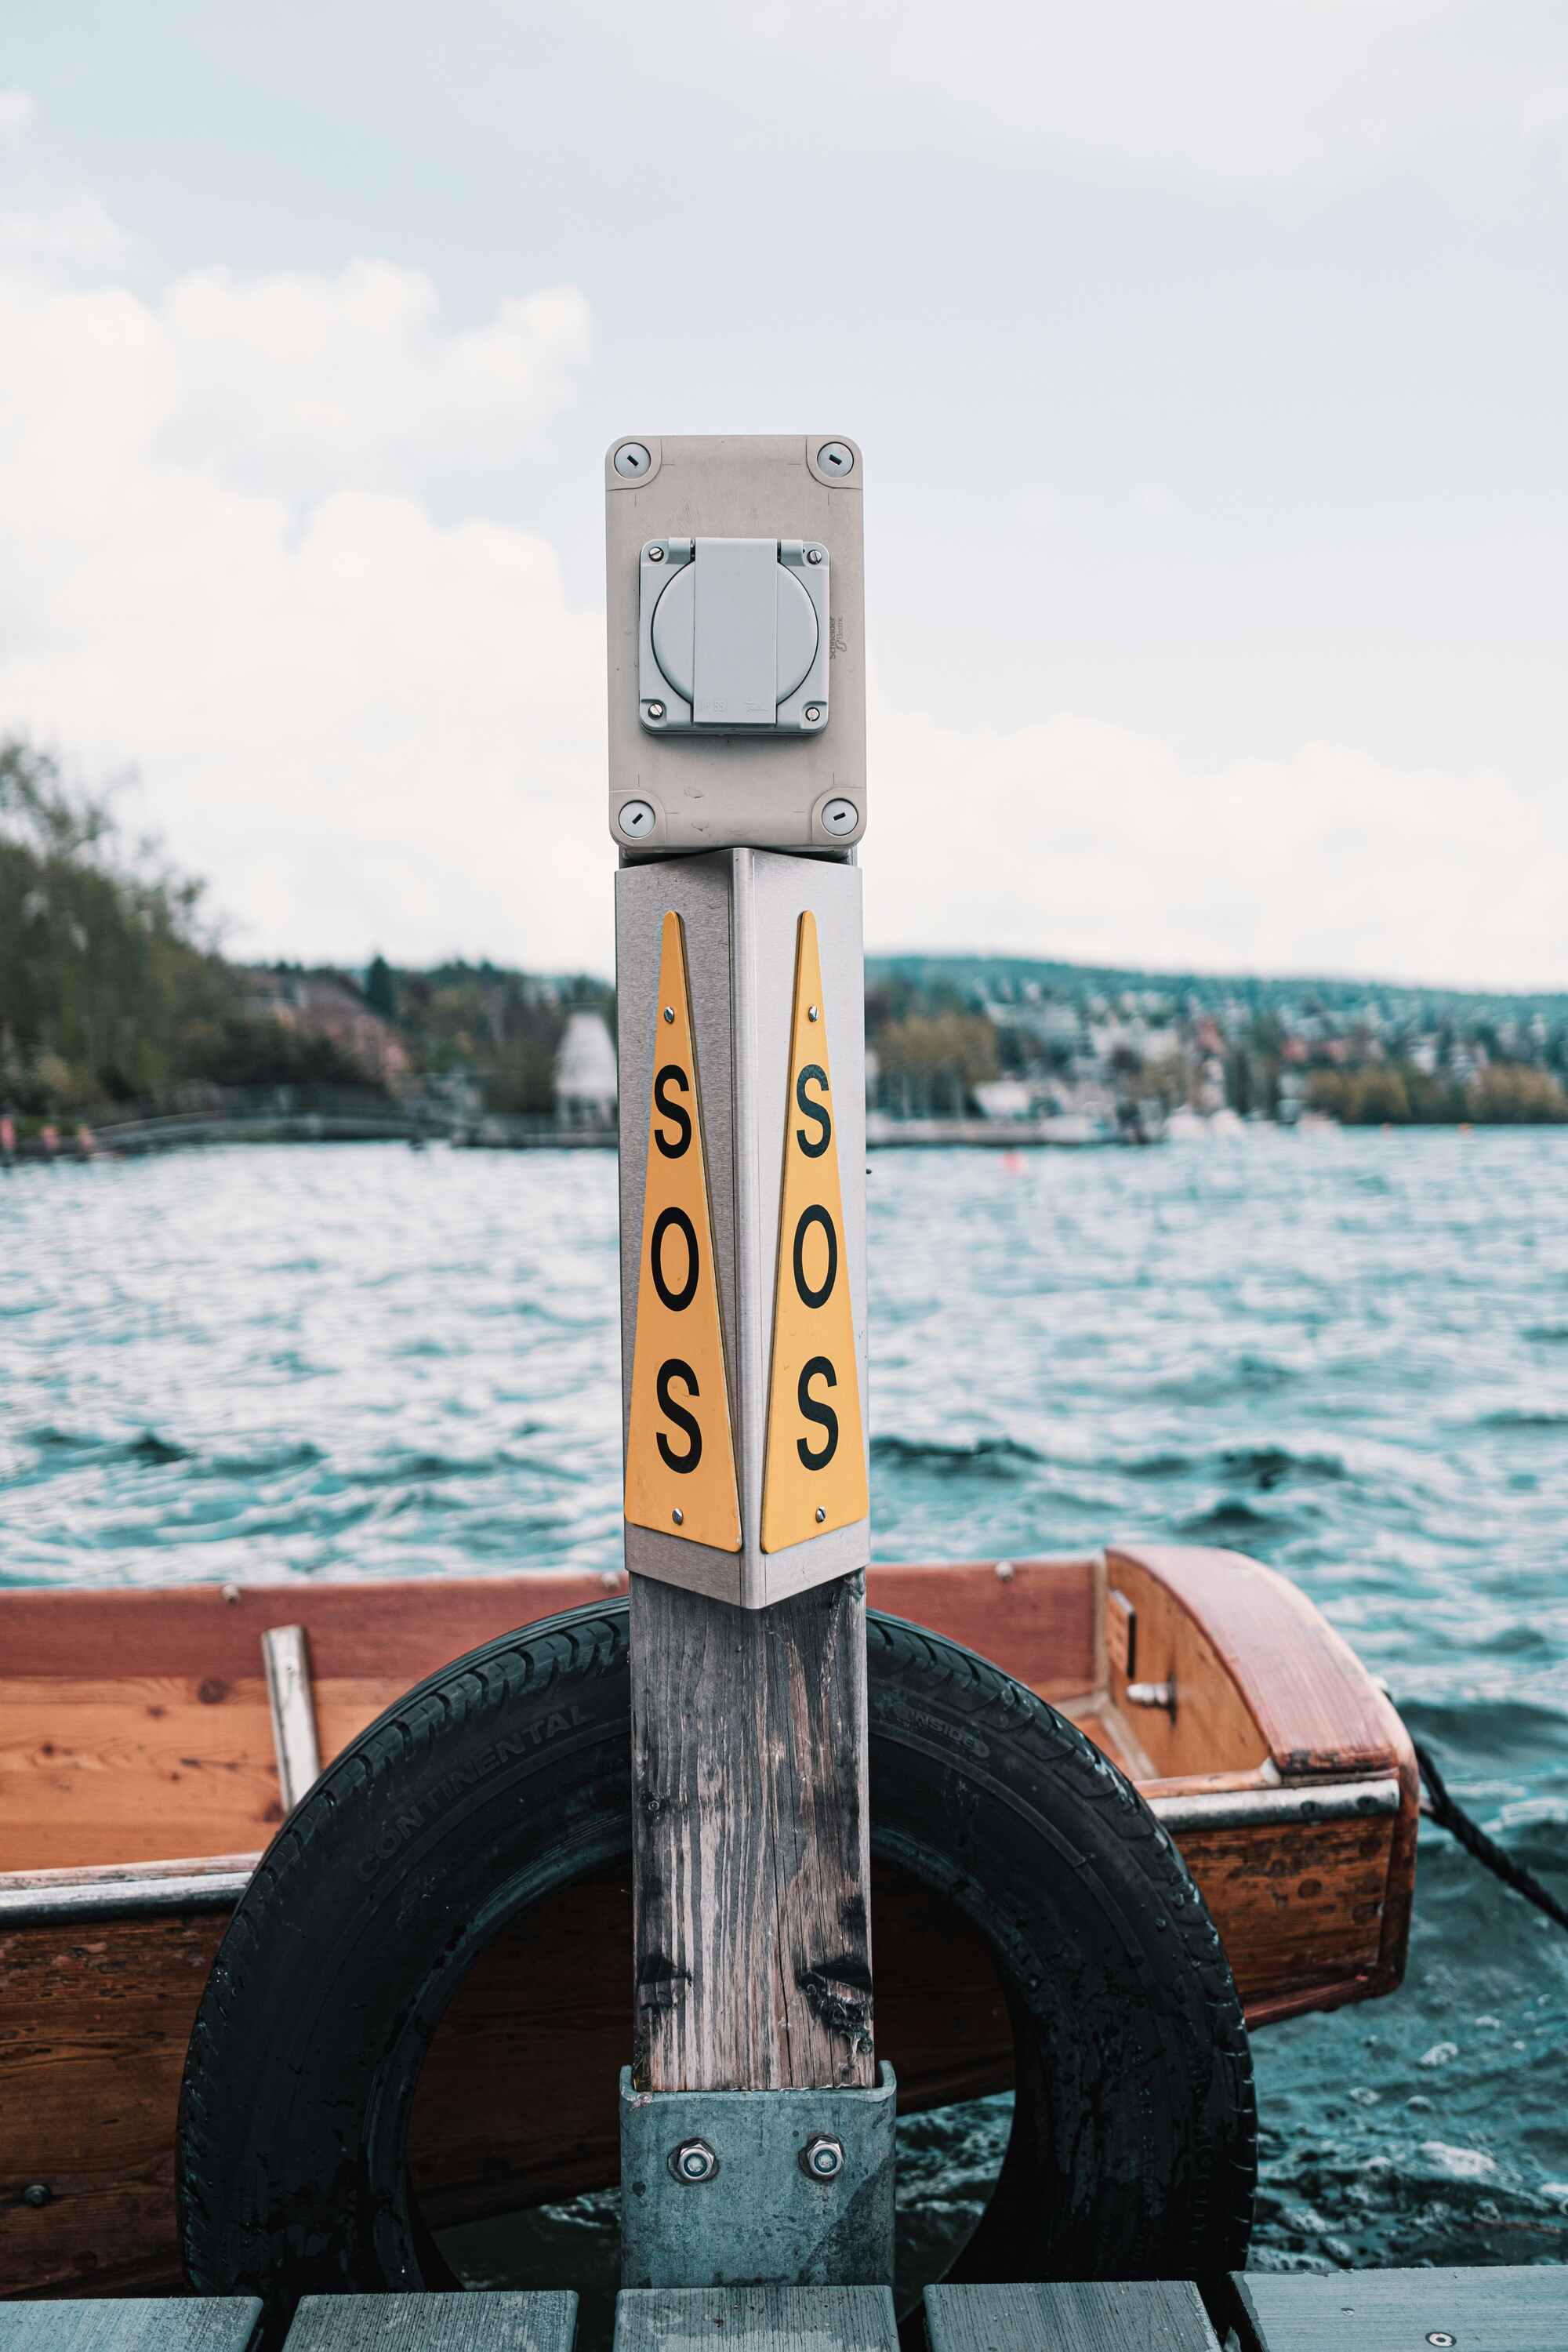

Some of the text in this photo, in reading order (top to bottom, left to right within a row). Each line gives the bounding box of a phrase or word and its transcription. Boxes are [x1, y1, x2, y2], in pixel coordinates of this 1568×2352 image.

[650, 1064, 703, 1475] SOS
[793, 1064, 840, 1471] SOS
[356, 1704, 597, 1882] CONTINENTAL
